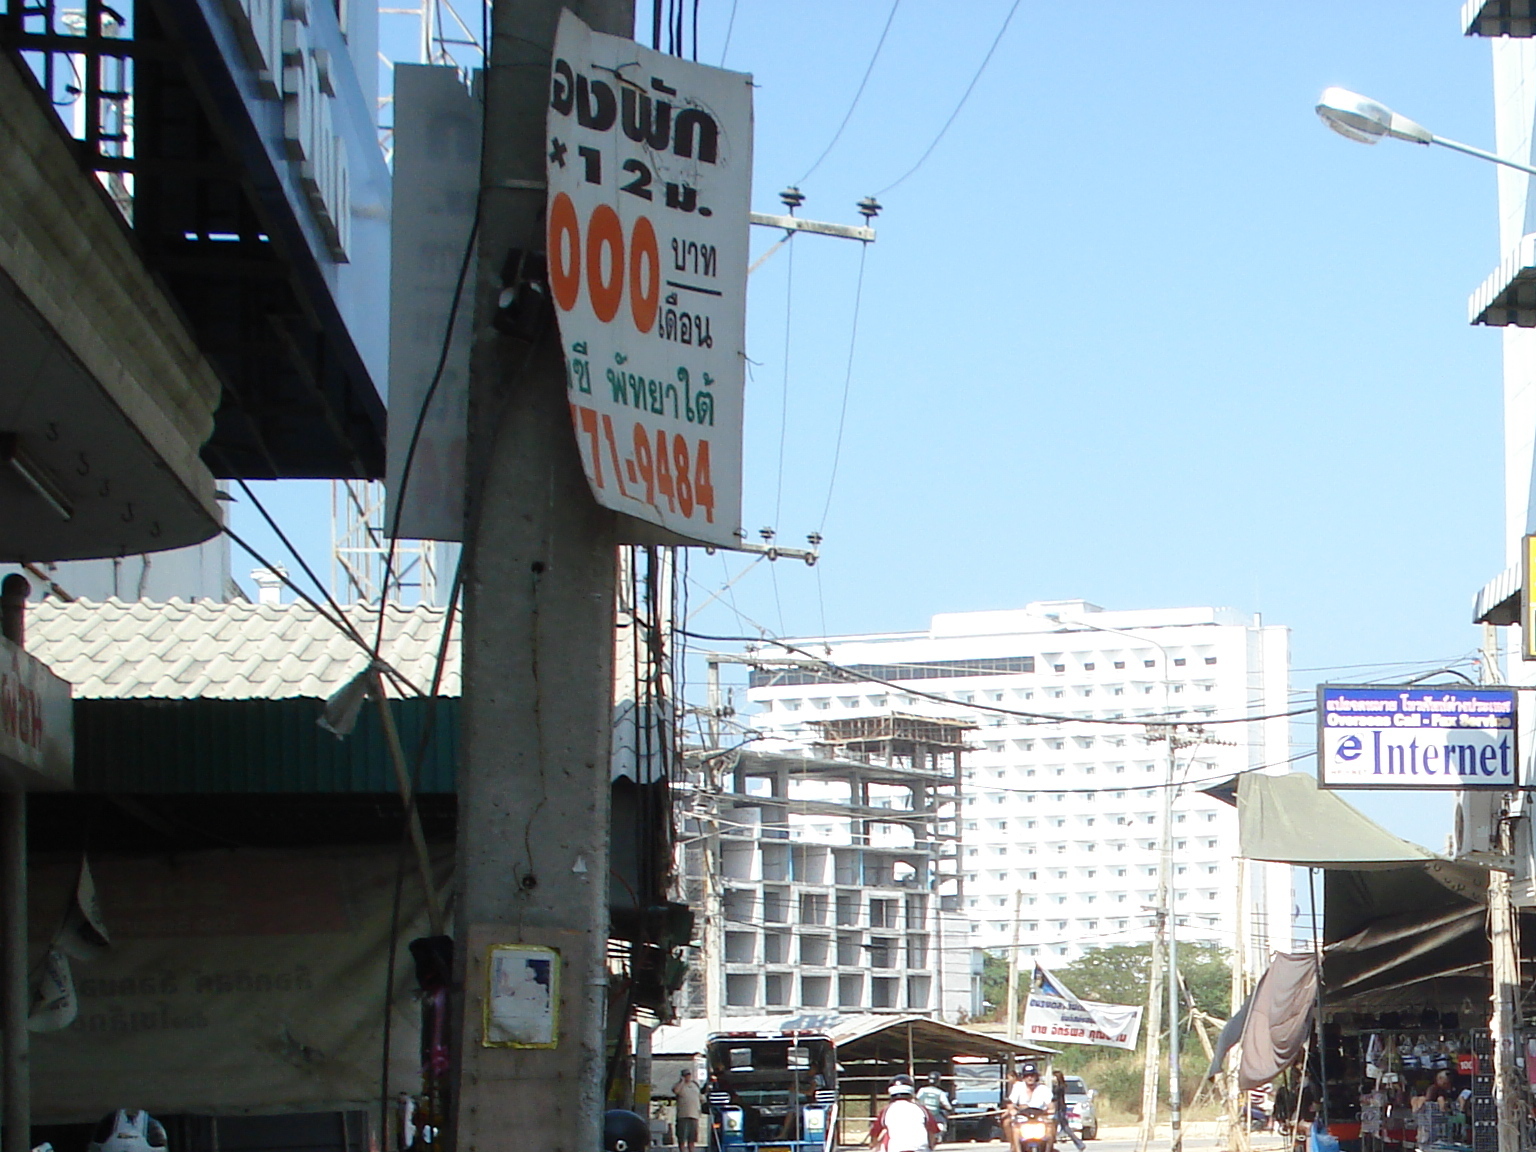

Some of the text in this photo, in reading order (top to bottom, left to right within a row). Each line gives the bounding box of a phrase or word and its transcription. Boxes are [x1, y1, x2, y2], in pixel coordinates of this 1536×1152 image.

[549, 191, 660, 334] 000
[671, 236, 718, 278] บาท
[658, 292, 713, 349] เดือน
[606, 352, 715, 427] พัทยาใต้
[1327, 713, 1391, 727] Overseas
[1393, 713, 1421, 727] Call
[1431, 714, 1458, 727] Fax
[1459, 714, 1511, 728] Service
[1371, 730, 1511, 776] Internet
